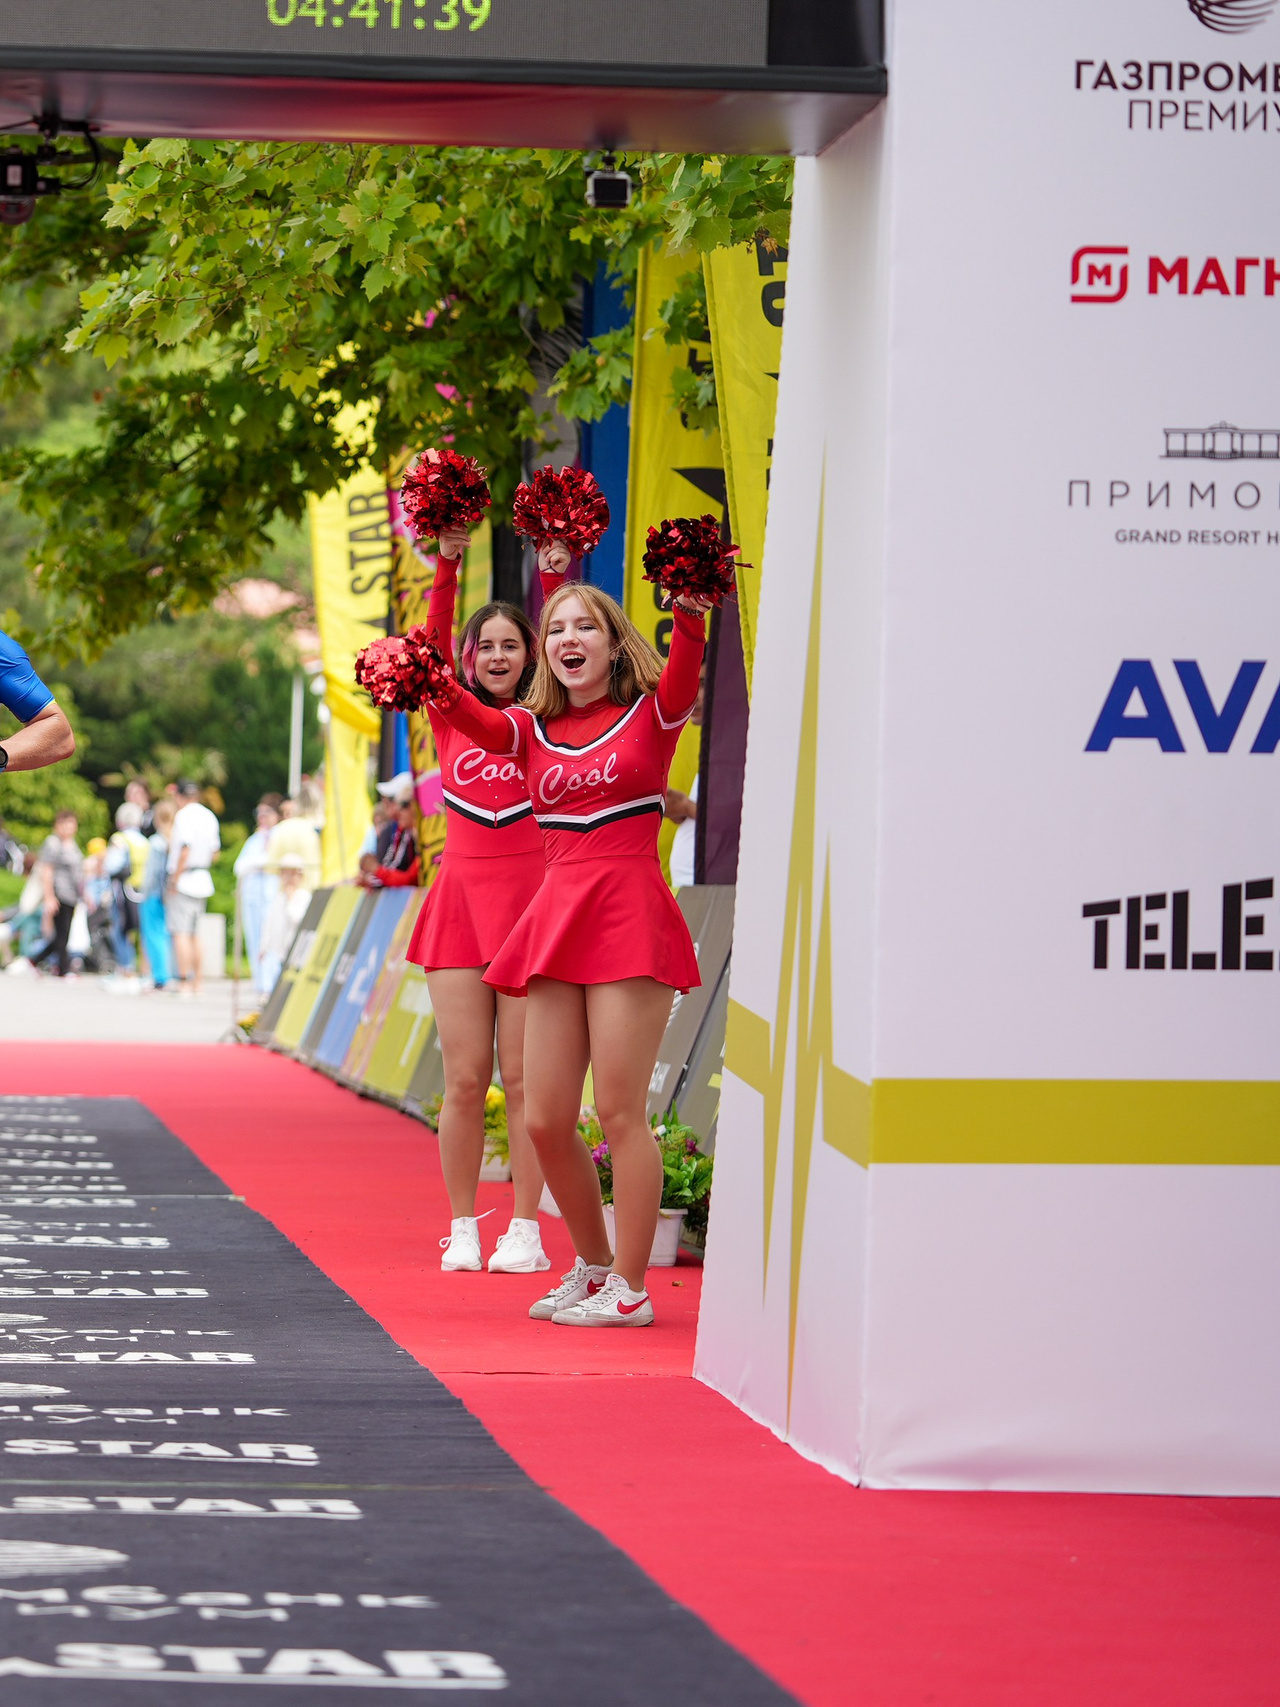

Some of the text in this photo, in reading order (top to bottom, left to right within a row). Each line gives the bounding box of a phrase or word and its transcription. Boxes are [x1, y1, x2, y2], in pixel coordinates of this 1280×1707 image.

[1128, 99, 1280, 132] ПРЕМИ
[1068, 480, 1280, 510] ПРИМО
[1115, 528, 1182, 545] GRAND
[1188, 529, 1261, 545] RESORT
[539, 752, 619, 804] Cool
[3, 1439, 320, 1460] STAR
[13, 1496, 362, 1514] STAR
[55, 1642, 506, 1680] STAR
